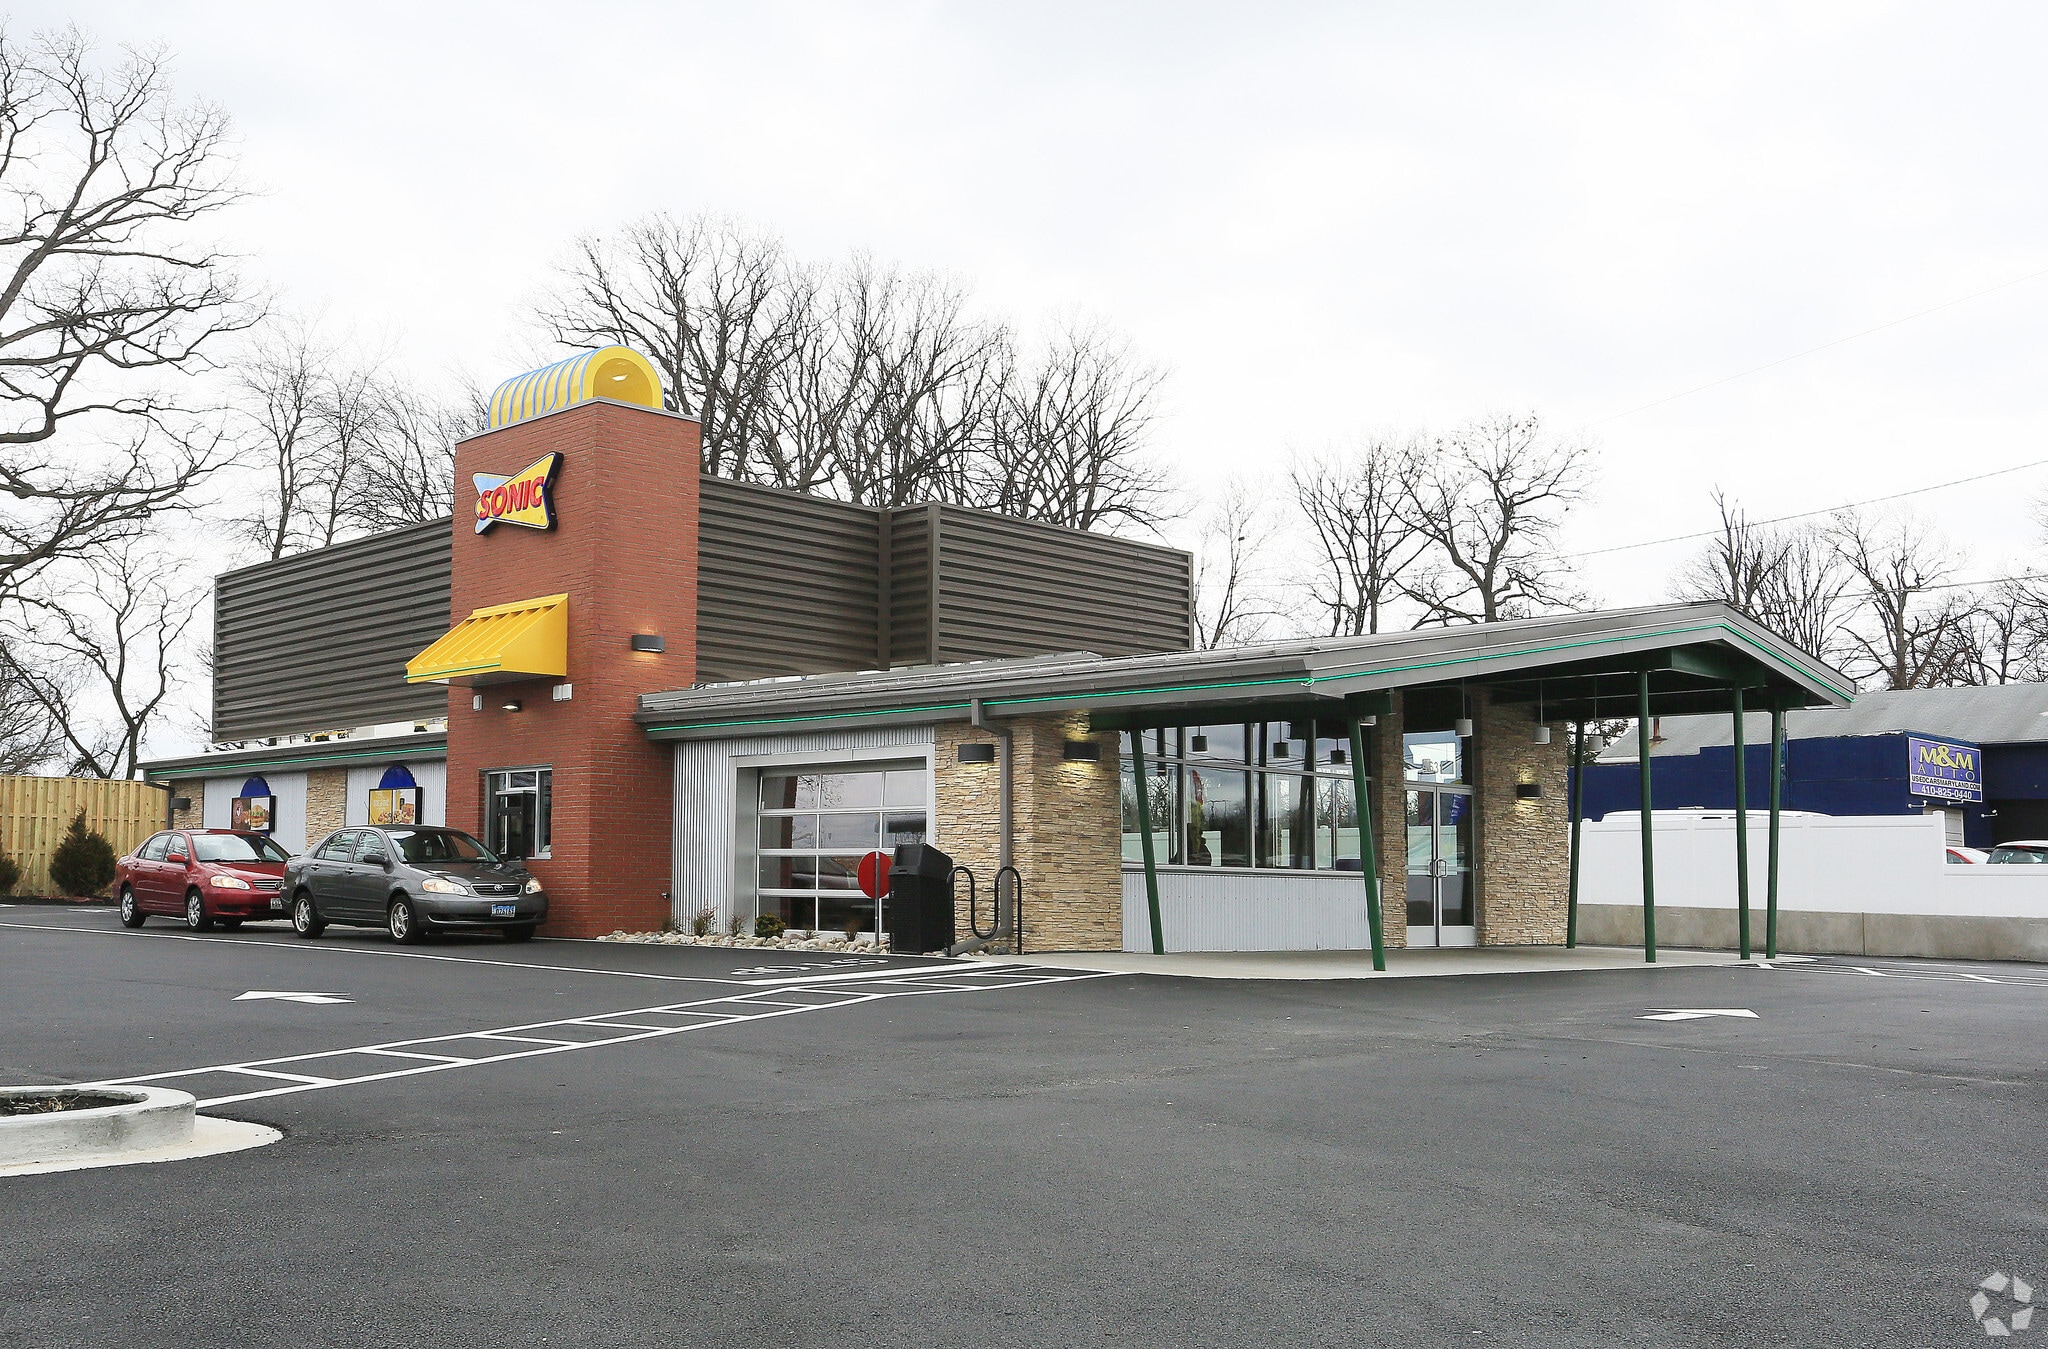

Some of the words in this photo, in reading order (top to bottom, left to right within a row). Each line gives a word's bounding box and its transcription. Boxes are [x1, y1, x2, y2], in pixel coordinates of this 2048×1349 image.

[479, 476, 545, 520] SONIC
[1919, 745, 1974, 771] M&M
[1917, 763, 1975, 781] AUTO
[1911, 775, 1981, 791] USEDCARSMARYLAND.COM
[1921, 785, 1973, 799] 410-825-0440
